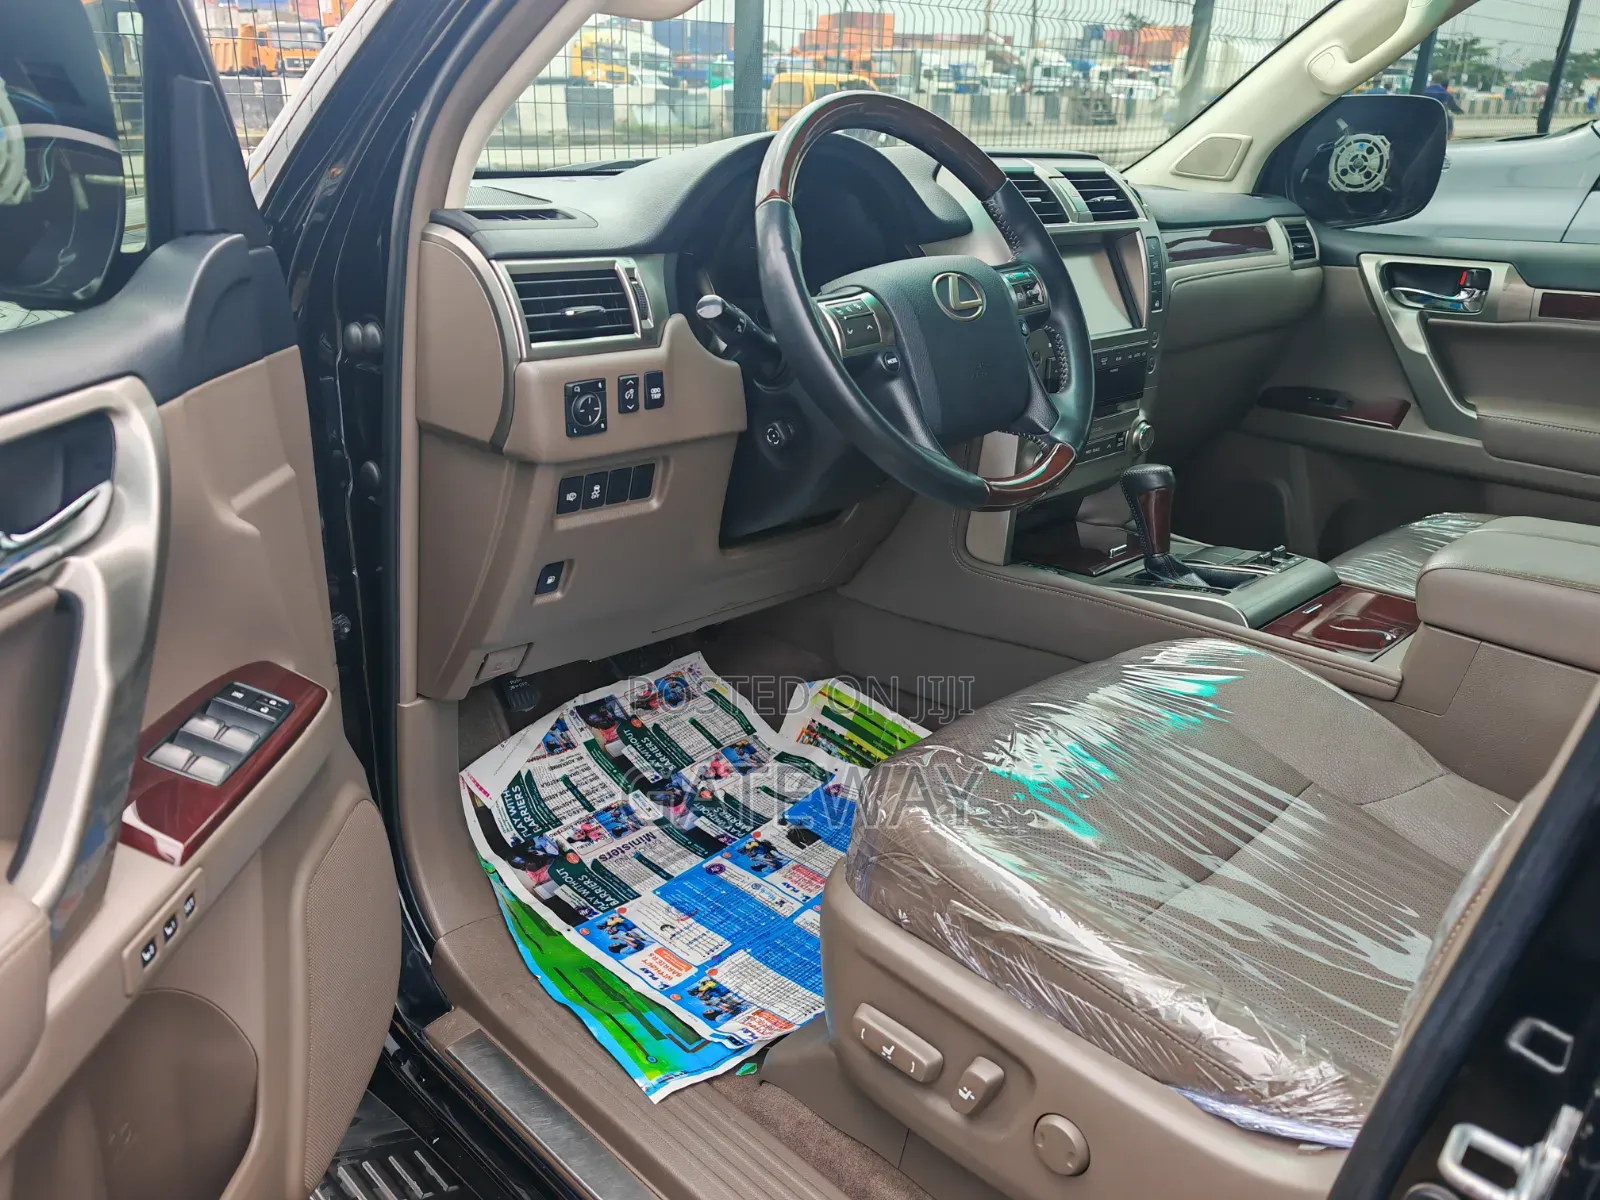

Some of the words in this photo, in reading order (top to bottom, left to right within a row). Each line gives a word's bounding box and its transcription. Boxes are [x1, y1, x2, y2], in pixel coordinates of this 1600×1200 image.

[622, 728, 651, 761] WITHOUT
[640, 736, 677, 772] BARRIERS
[511, 785, 543, 834] BARRIERS
[692, 801, 727, 827] WITHOUT
[713, 805, 754, 832] BARRIERS
[598, 830, 657, 864] Ministers
[555, 866, 590, 898] WITHOUT
[577, 873, 620, 907] BARRIERS
[781, 881, 801, 894] PLAY
[586, 894, 610, 913] PLAY
[639, 967, 660, 982] PLAY
[641, 958, 674, 982] WITHOUT
[648, 952, 683, 978] BARRIERS
